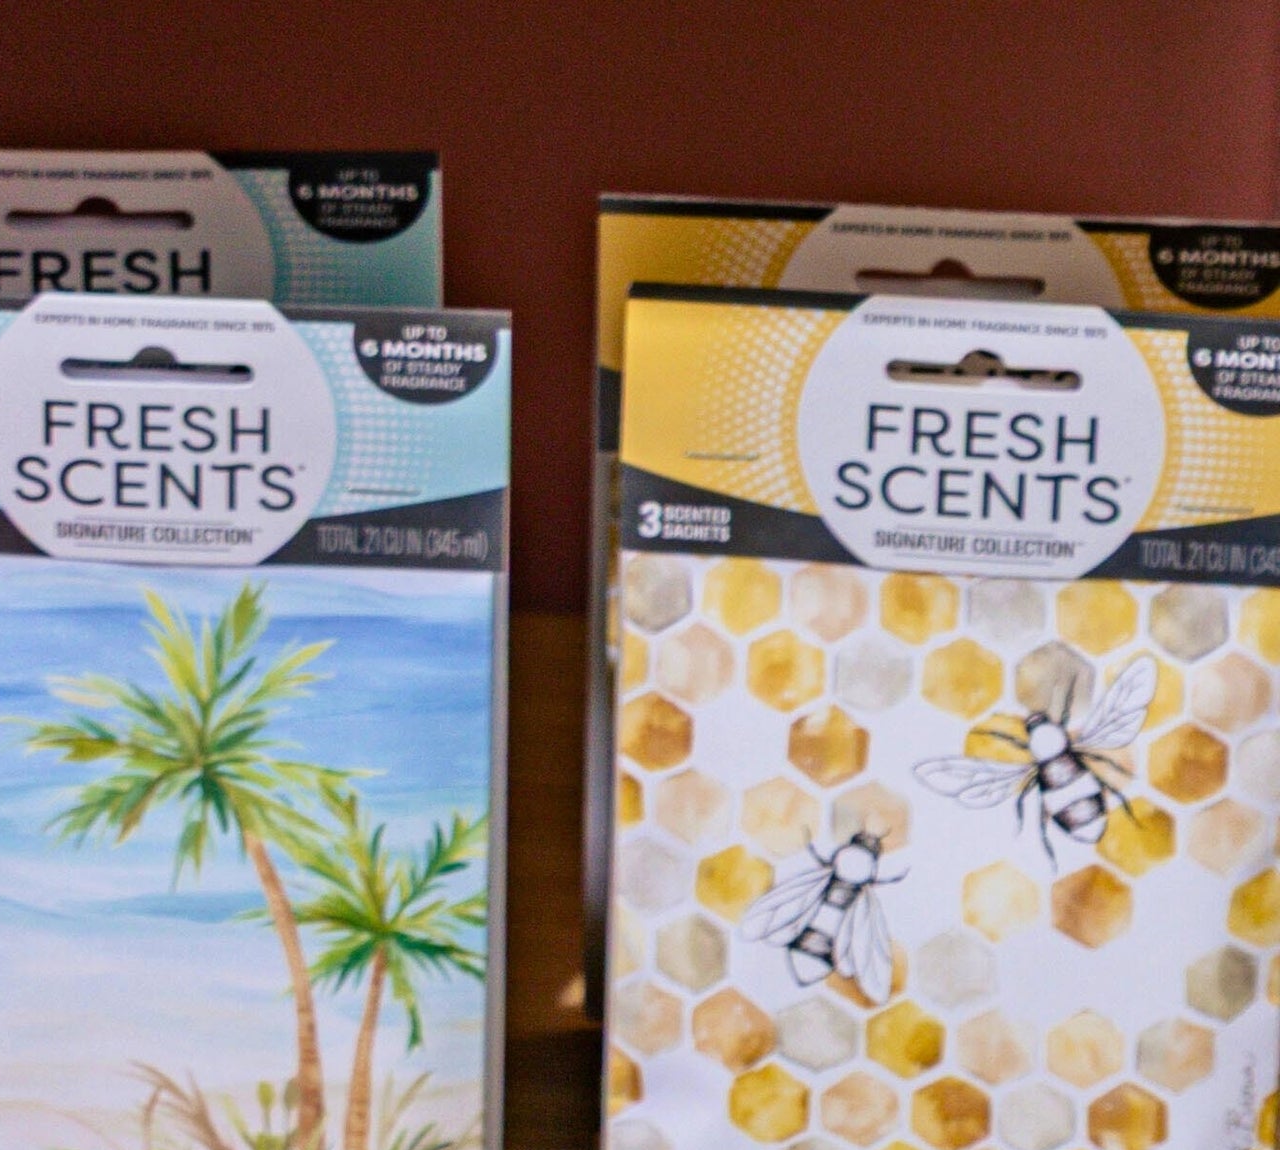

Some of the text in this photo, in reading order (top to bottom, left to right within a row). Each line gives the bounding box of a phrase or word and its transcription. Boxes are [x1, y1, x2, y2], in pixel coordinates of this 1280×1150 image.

[317, 183, 419, 201] MONTHS
[402, 324, 448, 342] UP TO
[1237, 335, 1259, 350] UP
[360, 338, 488, 363] 6 MONTHS
[1192, 347, 1212, 368] 6
[407, 360, 463, 378] STEADY
[382, 375, 468, 392] FRAGRANCE
[42, 399, 271, 454] FRESH
[865, 402, 1099, 465] FRESH
[13, 455, 297, 512] SCENTS
[833, 460, 1122, 525] SCENTS
[638, 500, 662, 539] 3
[663, 503, 731, 525] SCENTED
[56, 520, 254, 546] SIGNATURE COLLECTION
[662, 521, 731, 543] SACHETS
[874, 530, 1076, 559] SIGNATURE COLLECTION
